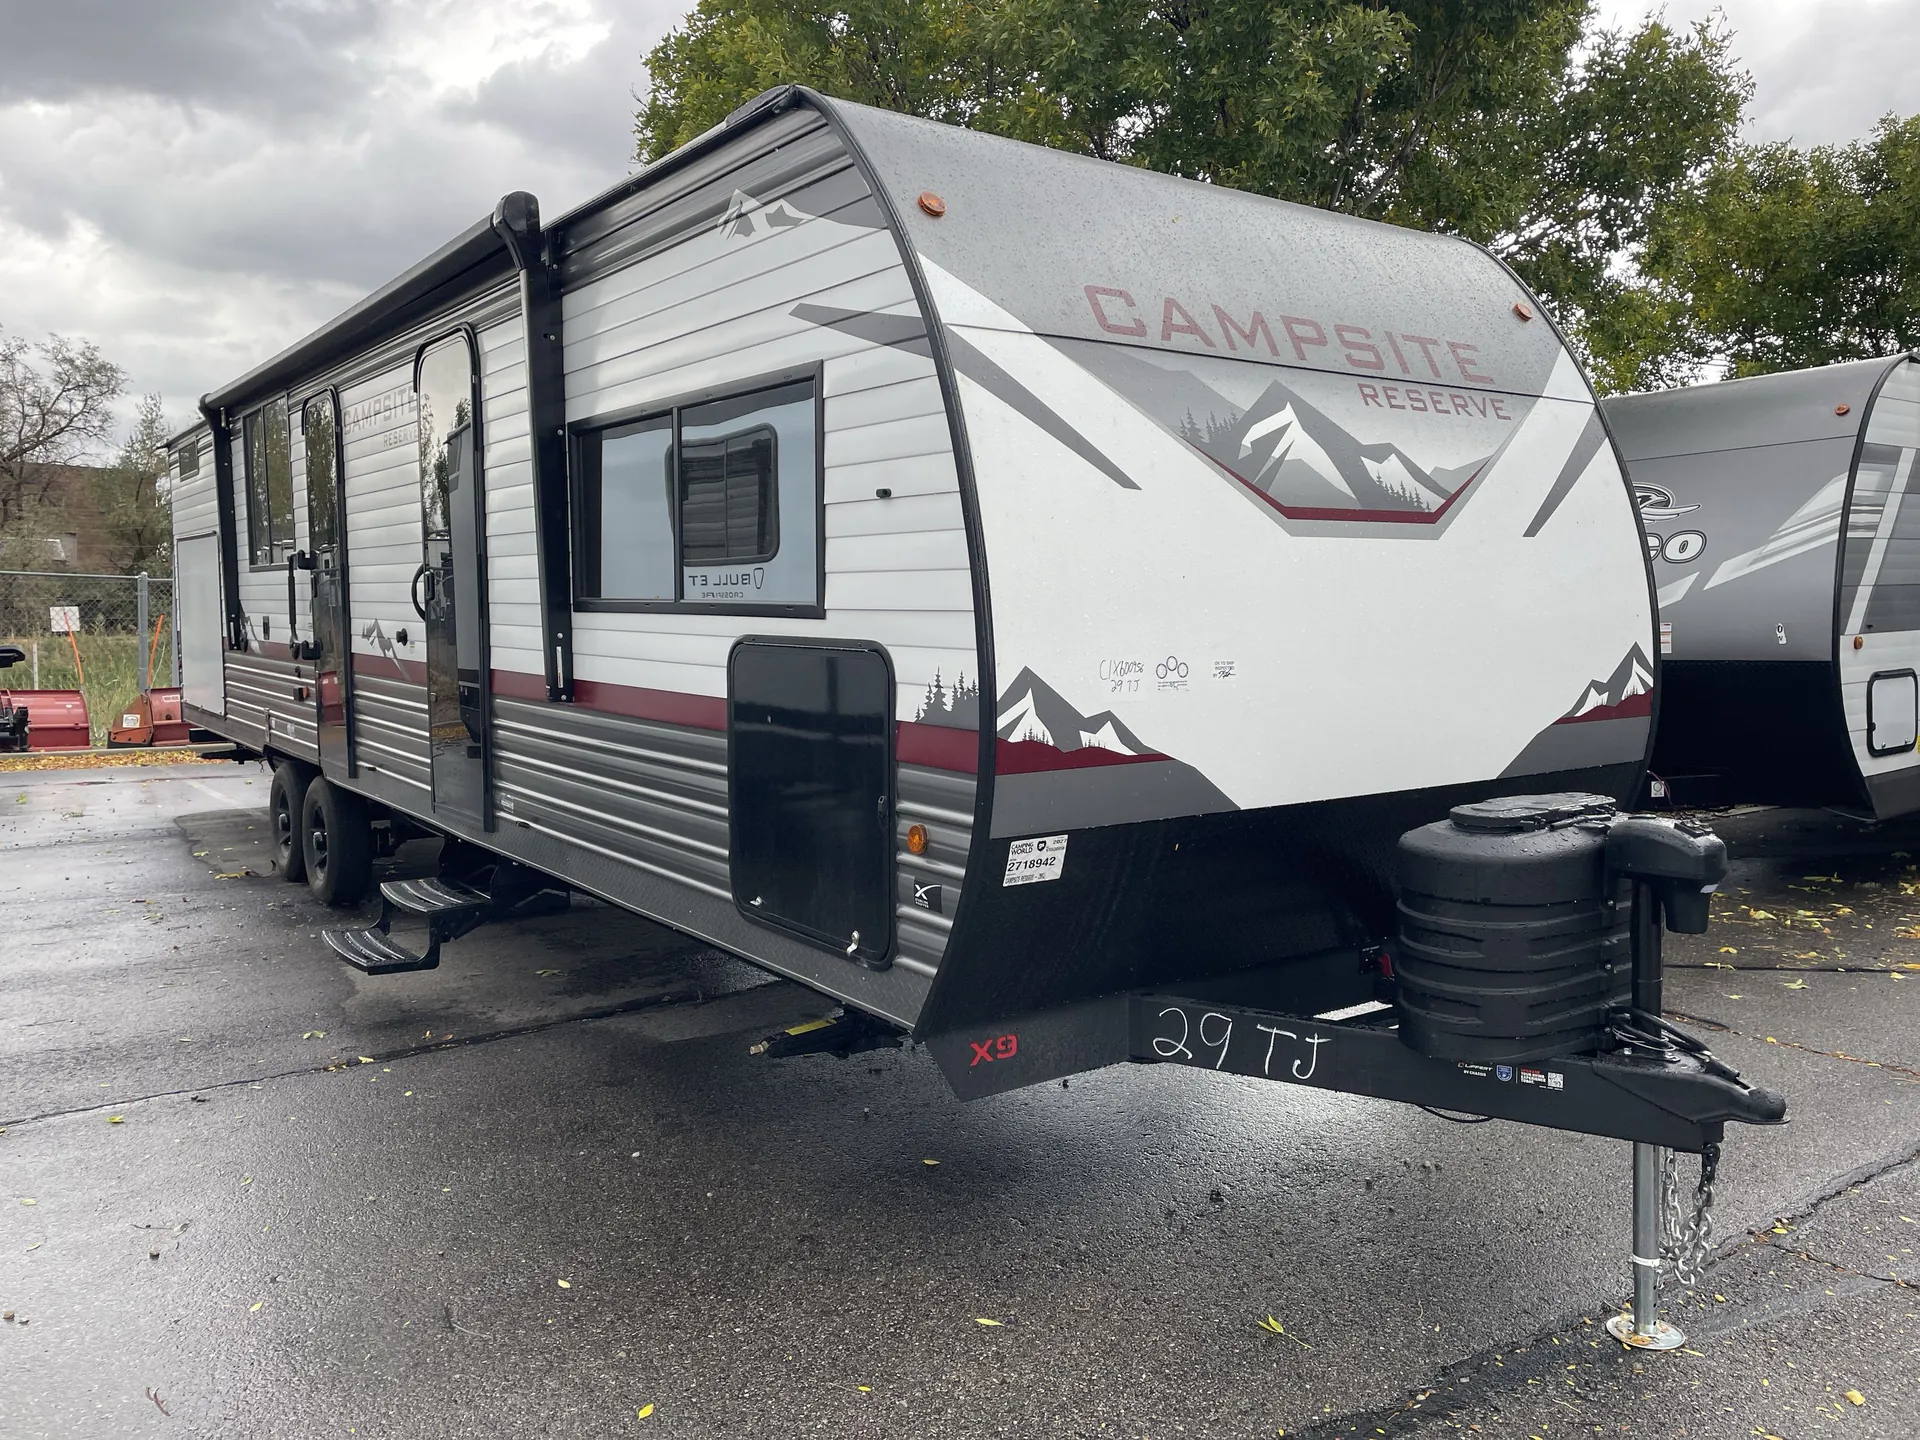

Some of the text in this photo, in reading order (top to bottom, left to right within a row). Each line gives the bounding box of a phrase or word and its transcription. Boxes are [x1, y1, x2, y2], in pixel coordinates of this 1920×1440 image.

[1084, 285, 1496, 384] CAMPSITE
[343, 386, 417, 436] CAMPSITE
[1358, 383, 1512, 421] RESERVE
[383, 426, 418, 448] RESERVE
[1007, 856, 1056, 872] 2718942
[970, 1034, 1018, 1066] X9
[1152, 1007, 1332, 1079] 29 TJ
